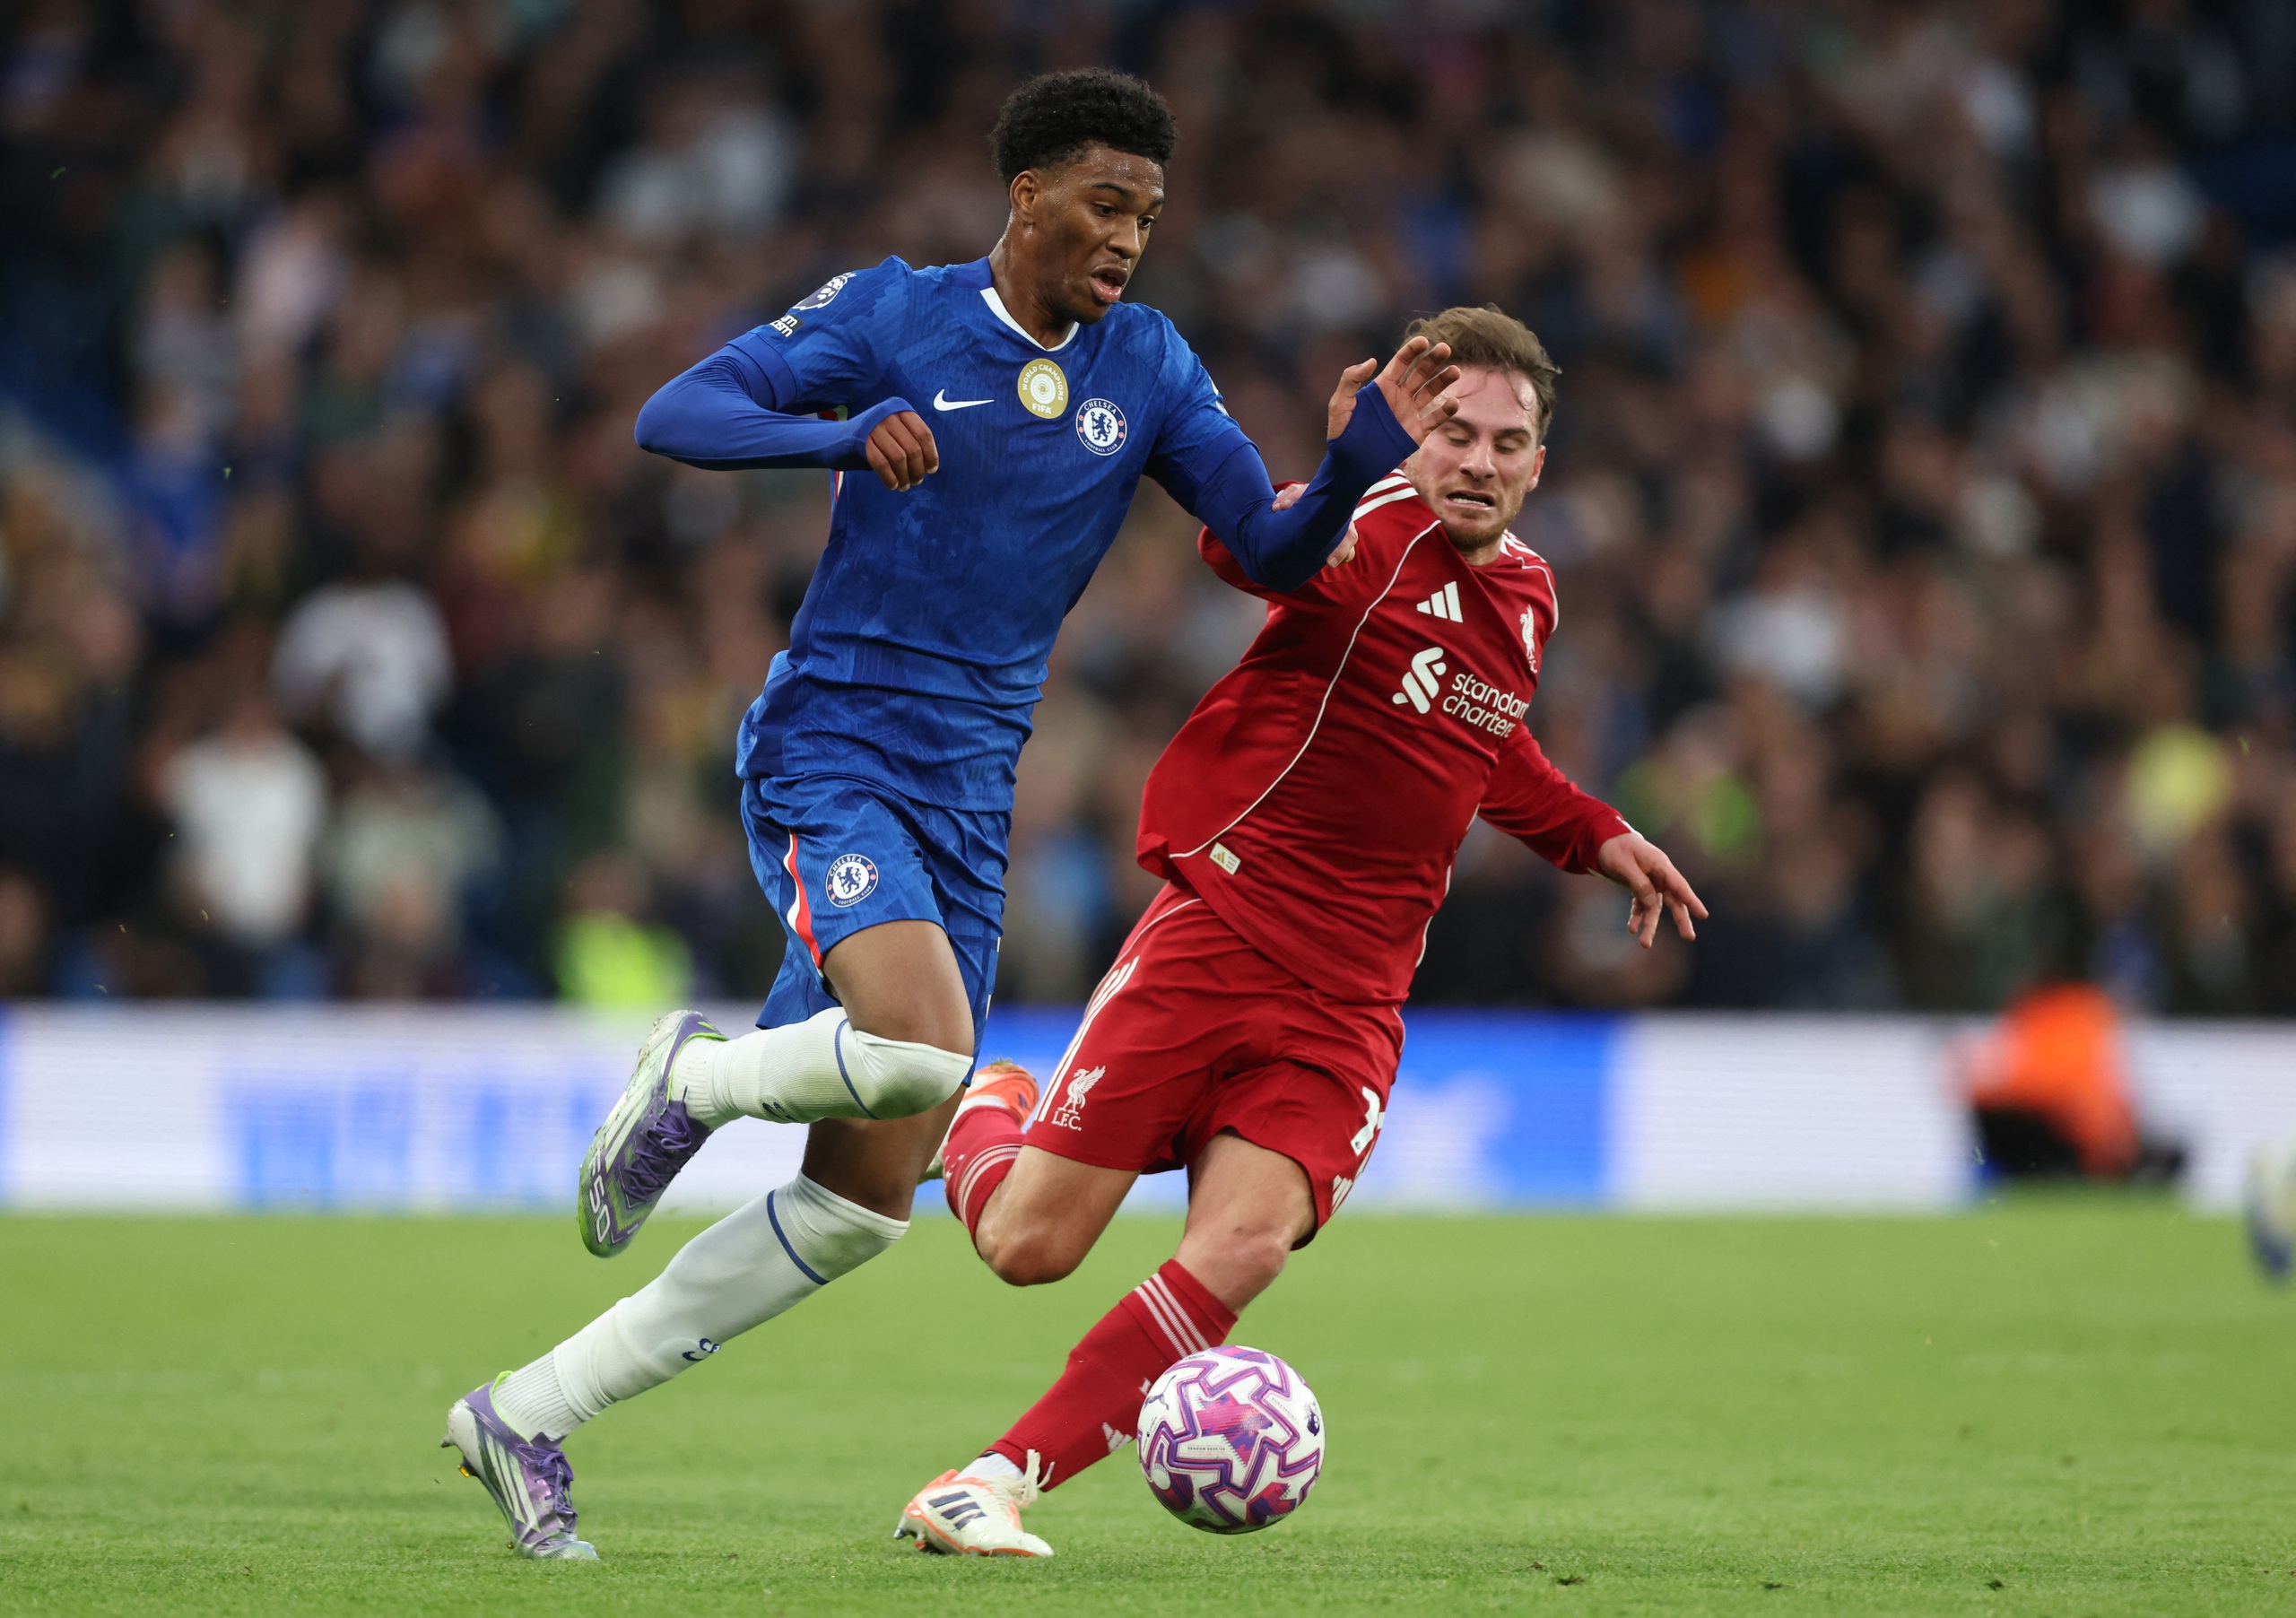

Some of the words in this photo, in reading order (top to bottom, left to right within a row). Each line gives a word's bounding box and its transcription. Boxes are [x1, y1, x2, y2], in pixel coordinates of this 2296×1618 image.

[1022, 365, 1038, 390] WORLD
[1039, 363, 1065, 402] CHAMPIONS
[1031, 403, 1052, 414] FIFA
[1084, 400, 1117, 414] CHELSEA
[1084, 439, 1106, 452] FOOTBALL
[1107, 443, 1118, 452] CLUB
[829, 856, 862, 877] CHELSEA
[587, 1147, 611, 1243] F50
